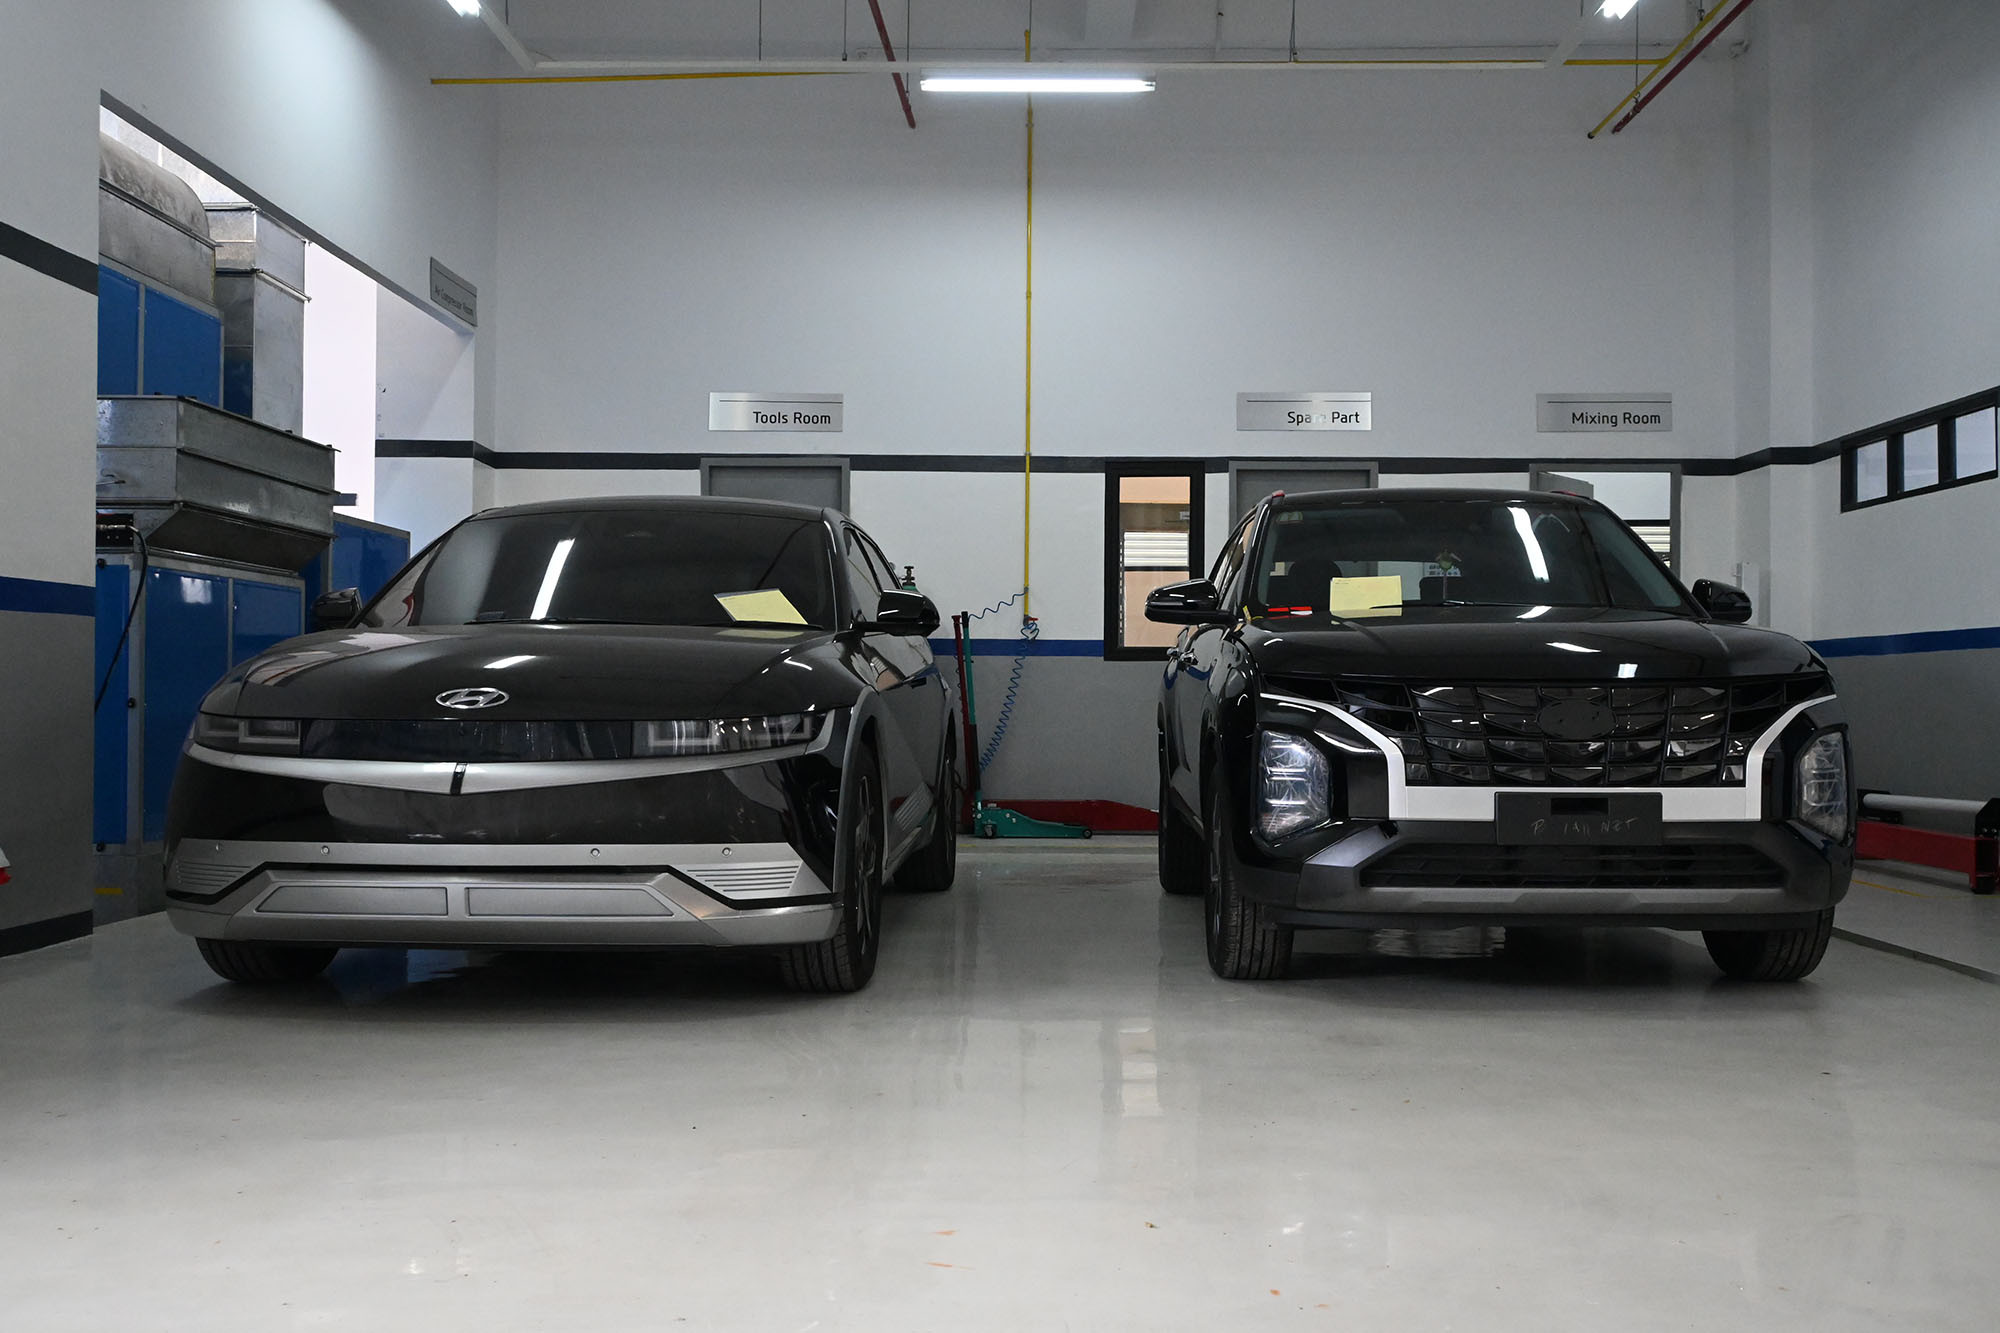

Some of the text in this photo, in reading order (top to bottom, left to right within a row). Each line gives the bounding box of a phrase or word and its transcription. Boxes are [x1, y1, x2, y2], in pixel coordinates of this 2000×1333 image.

[752, 411, 831, 425] Tools Room
[1331, 411, 1360, 424] Part
[1571, 411, 1661, 428] Mixing Room
